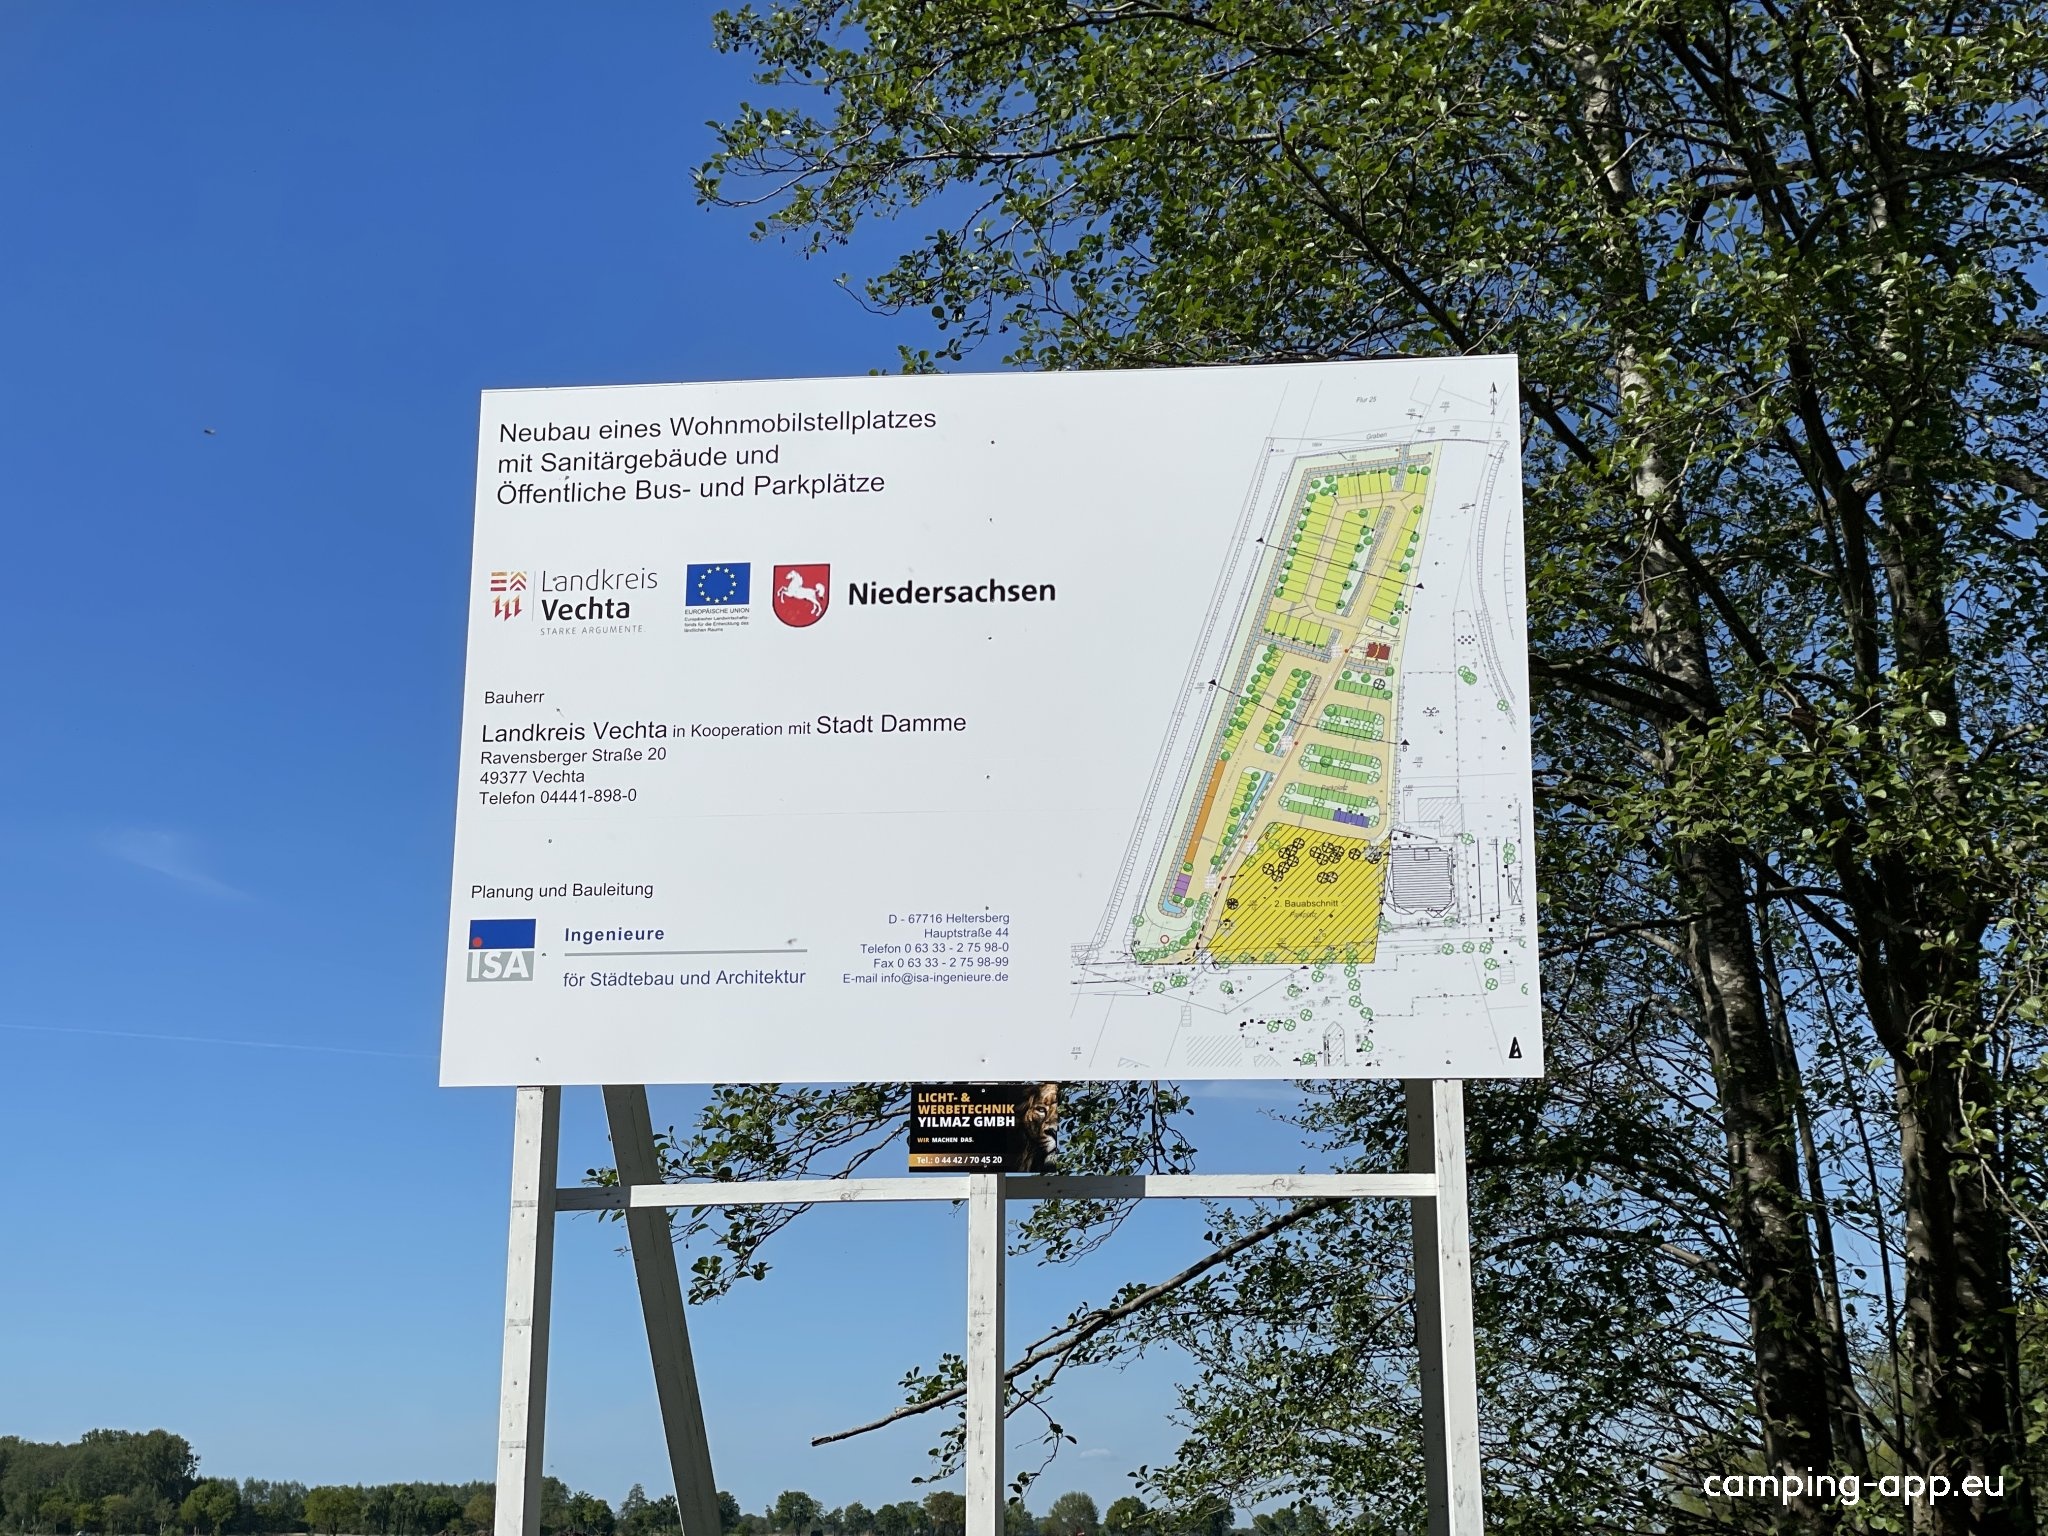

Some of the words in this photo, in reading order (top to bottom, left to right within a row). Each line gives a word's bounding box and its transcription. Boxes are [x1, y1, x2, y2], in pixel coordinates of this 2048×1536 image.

[500, 422, 590, 442] Neubau
[599, 420, 661, 439] eines
[670, 410, 936, 436] Wohnmobilstellplatzes
[499, 454, 533, 473] mit
[541, 447, 727, 474] Sanitärgebäude
[737, 444, 778, 465] und
[496, 480, 627, 505] Öffentliche
[636, 480, 691, 500] Bus-
[701, 476, 744, 497] und
[755, 473, 884, 499] Parkplätze
[542, 568, 658, 592] Landkreis
[849, 578, 1055, 605] Niedersachsen
[541, 597, 630, 621] Vechta
[540, 627, 577, 636] STARKE
[485, 691, 545, 704] Bauherr
[483, 722, 585, 742] Landkreis
[593, 721, 667, 739] Vechta
[673, 725, 685, 737] in
[691, 722, 782, 739] Kooperation
[789, 721, 811, 735] mit
[817, 715, 873, 734] Stadt
[882, 714, 966, 732] Damme
[481, 750, 588, 766] Ravensberger
[592, 748, 642, 762] Straße
[648, 747, 666, 760] 20
[480, 771, 527, 784] 49377
[532, 770, 584, 783] Vechta
[479, 791, 535, 805] Telefon
[541, 788, 636, 803] 04441-898-0
[472, 885, 533, 901] Planung
[539, 883, 567, 897] und
[573, 882, 653, 898] Bauleitung
[1274, 900, 1283, 908] 2.
[1285, 900, 1338, 908] Bauabschnitt
[889, 914, 897, 924] D
[908, 914, 942, 923] 67716
[946, 913, 1010, 924] Heltersberg
[565, 927, 664, 945] Ingenieure
[925, 928, 992, 940] Hauptstraße
[995, 928, 1008, 937] 44
[860, 944, 901, 953] Telefon
[905, 944, 911, 953] 0
[915, 943, 928, 953] 63
[932, 943, 945, 953] 33
[957, 943, 963, 952] 2
[968, 943, 980, 952] 75
[985, 942, 1009, 952] 98-0
[471, 951, 529, 978] ISA
[874, 959, 894, 968] Fax
[898, 958, 904, 968] 0
[908, 958, 921, 967] 63
[925, 958, 938, 967] 33
[950, 958, 956, 967] 2
[960, 957, 973, 967] 75
[977, 957, 1008, 967] 98-99
[563, 973, 585, 987] för
[590, 971, 674, 986] Städtebau
[681, 970, 710, 985] und
[716, 969, 806, 984] Architektur
[843, 973, 877, 983] E-mail
[882, 972, 1008, 985] info@isa-ingenieure.de
[918, 1093, 957, 1103] LICHT-
[961, 1093, 970, 1102] &
[918, 1104, 1014, 1114] WERBETECHNIK
[918, 1116, 971, 1127] YILMAZ
[974, 1116, 1015, 1126] GMBH
